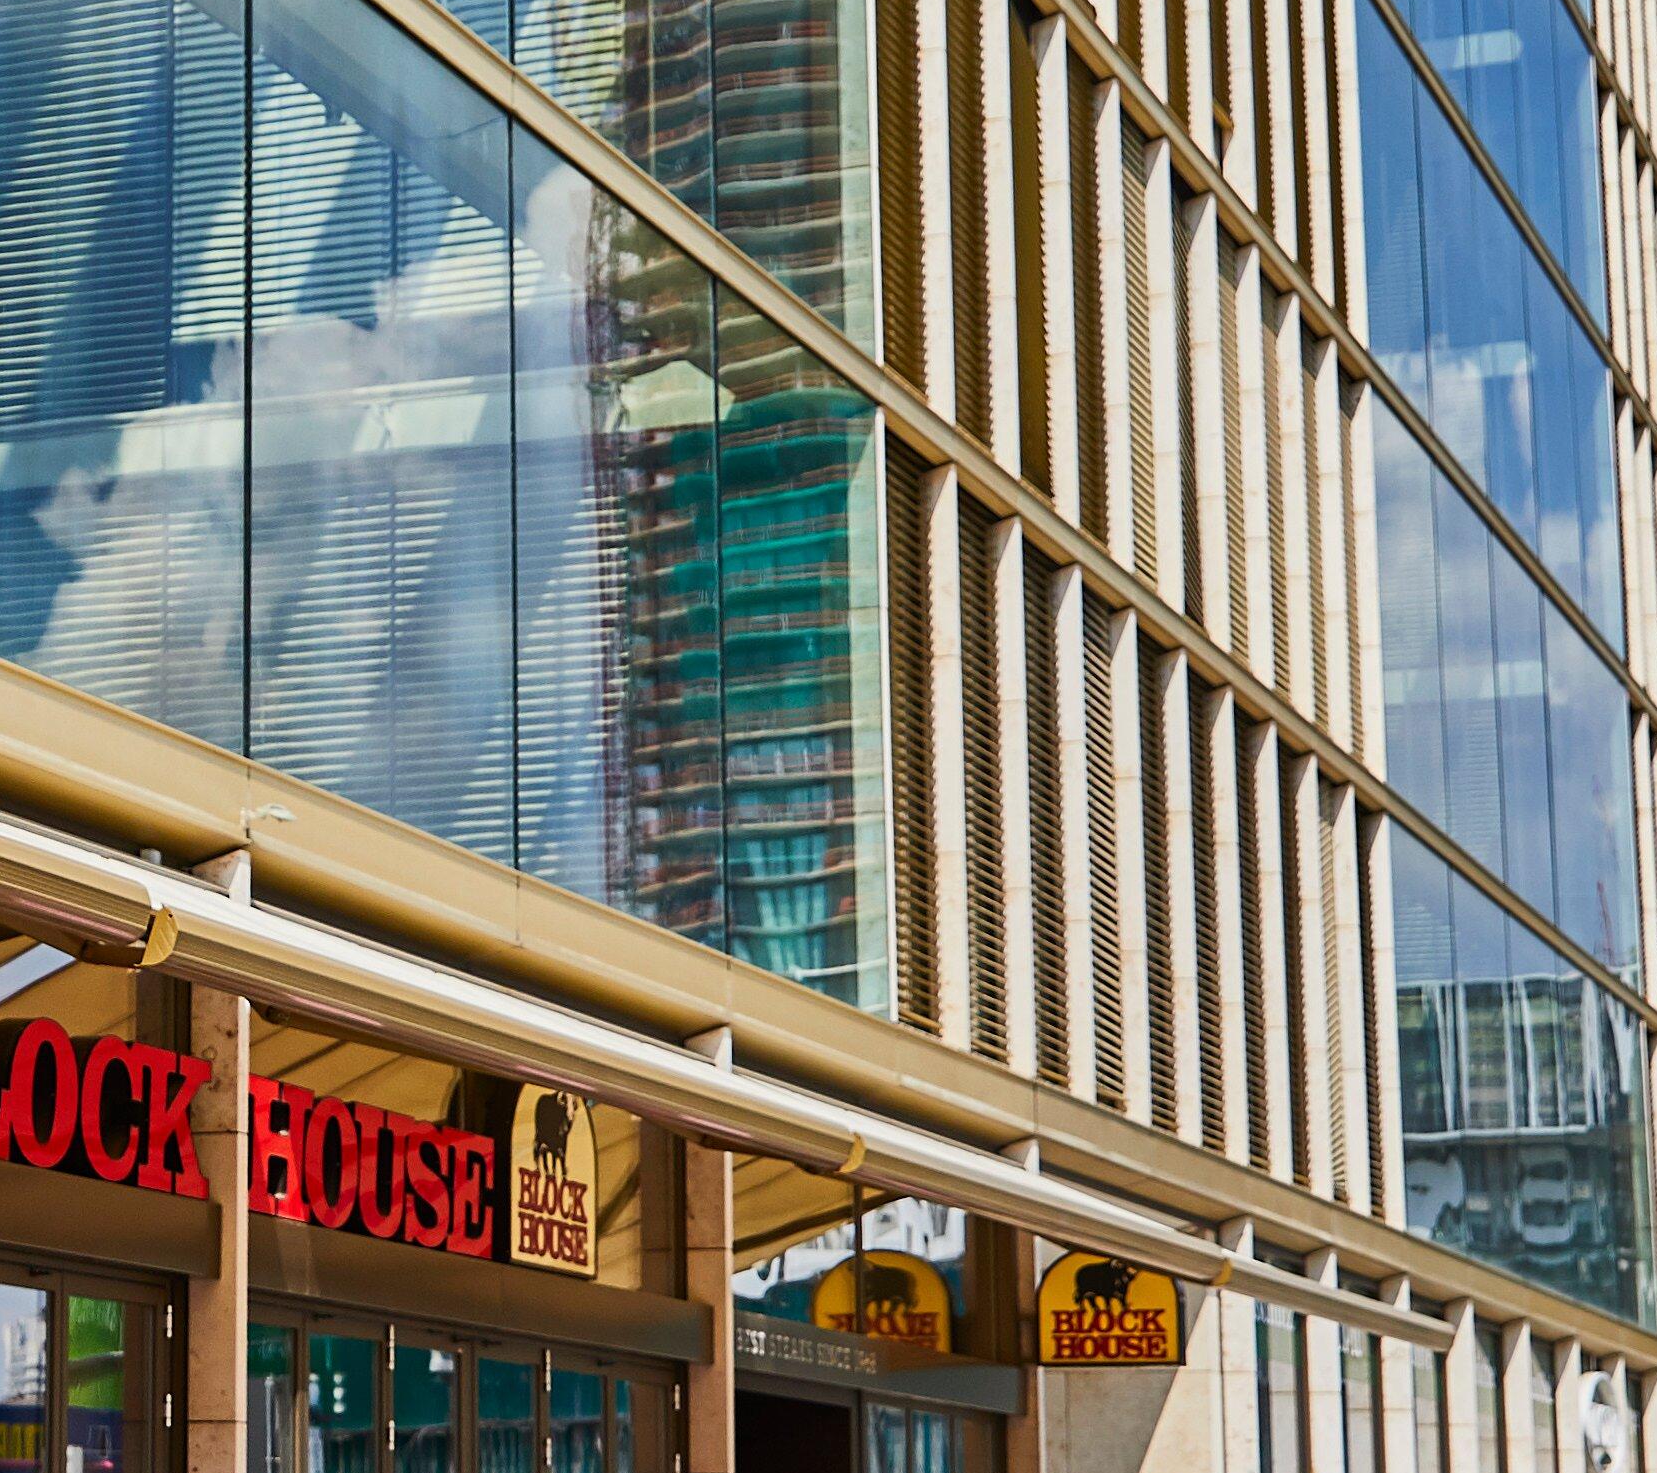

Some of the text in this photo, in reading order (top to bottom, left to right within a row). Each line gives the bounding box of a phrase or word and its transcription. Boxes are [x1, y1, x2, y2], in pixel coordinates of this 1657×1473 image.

[247, 1071, 495, 1260] HOUSE
[518, 1166, 588, 1224] BLOCK
[518, 1211, 588, 1267] HOUSE
[1051, 1308, 1166, 1334] BLOCK
[1052, 1334, 1168, 1360] HOUSE
